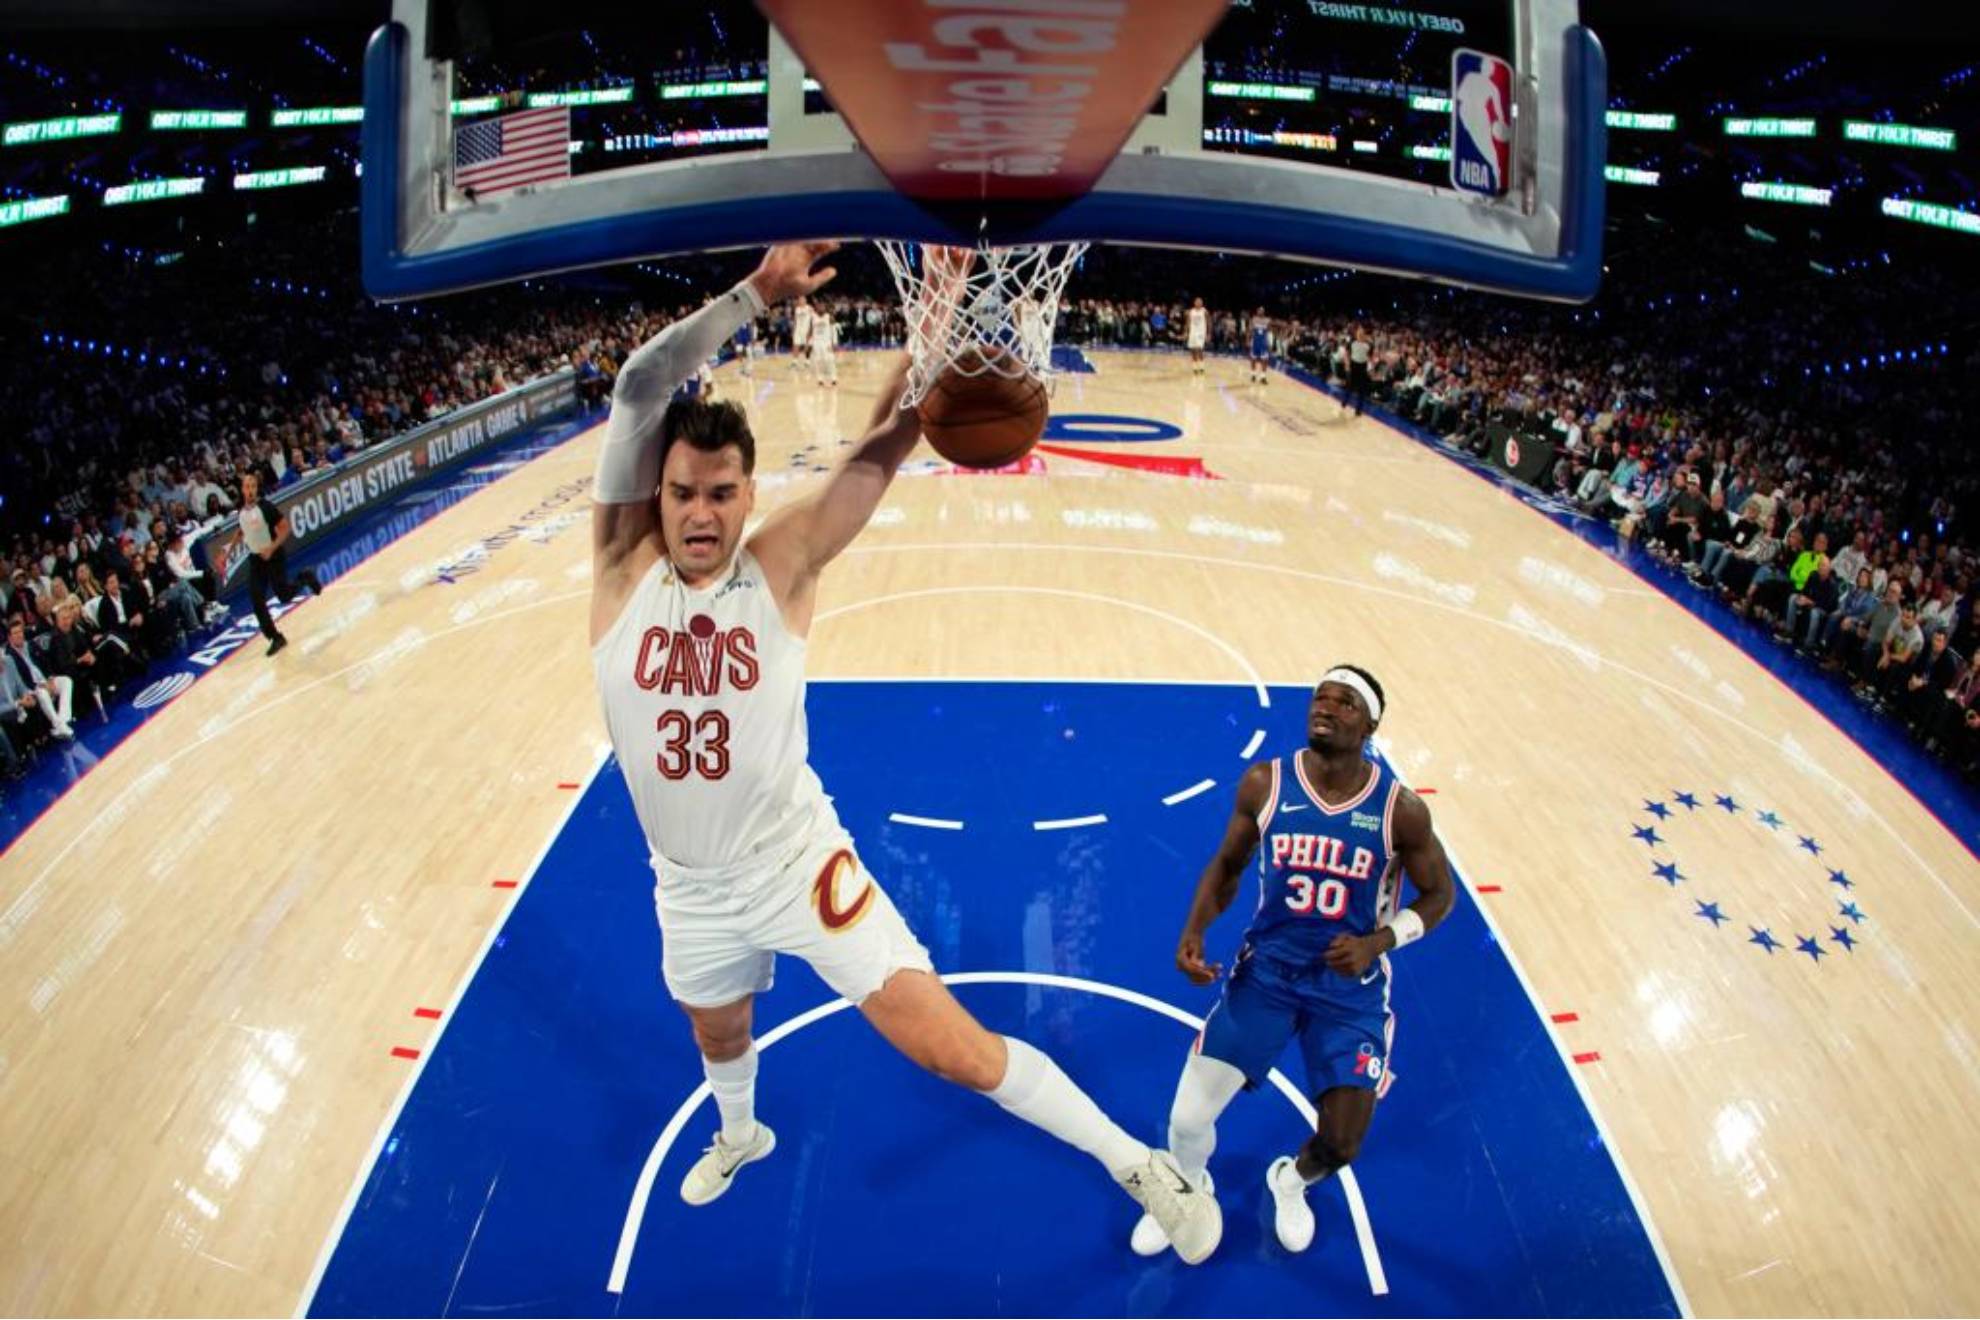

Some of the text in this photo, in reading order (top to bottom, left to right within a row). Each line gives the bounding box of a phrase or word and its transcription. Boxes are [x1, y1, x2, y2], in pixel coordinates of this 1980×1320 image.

[1460, 160, 1490, 189] NBA
[290, 475, 365, 539] GOLDEN
[366, 451, 416, 497] STATE
[427, 420, 485, 468] ATLANTA
[487, 404, 519, 439] GAME
[633, 625, 761, 696] CAVS
[657, 709, 730, 781] 33
[810, 848, 876, 935] C
[1271, 833, 1375, 880] PHILA
[1285, 874, 1350, 920] 30
